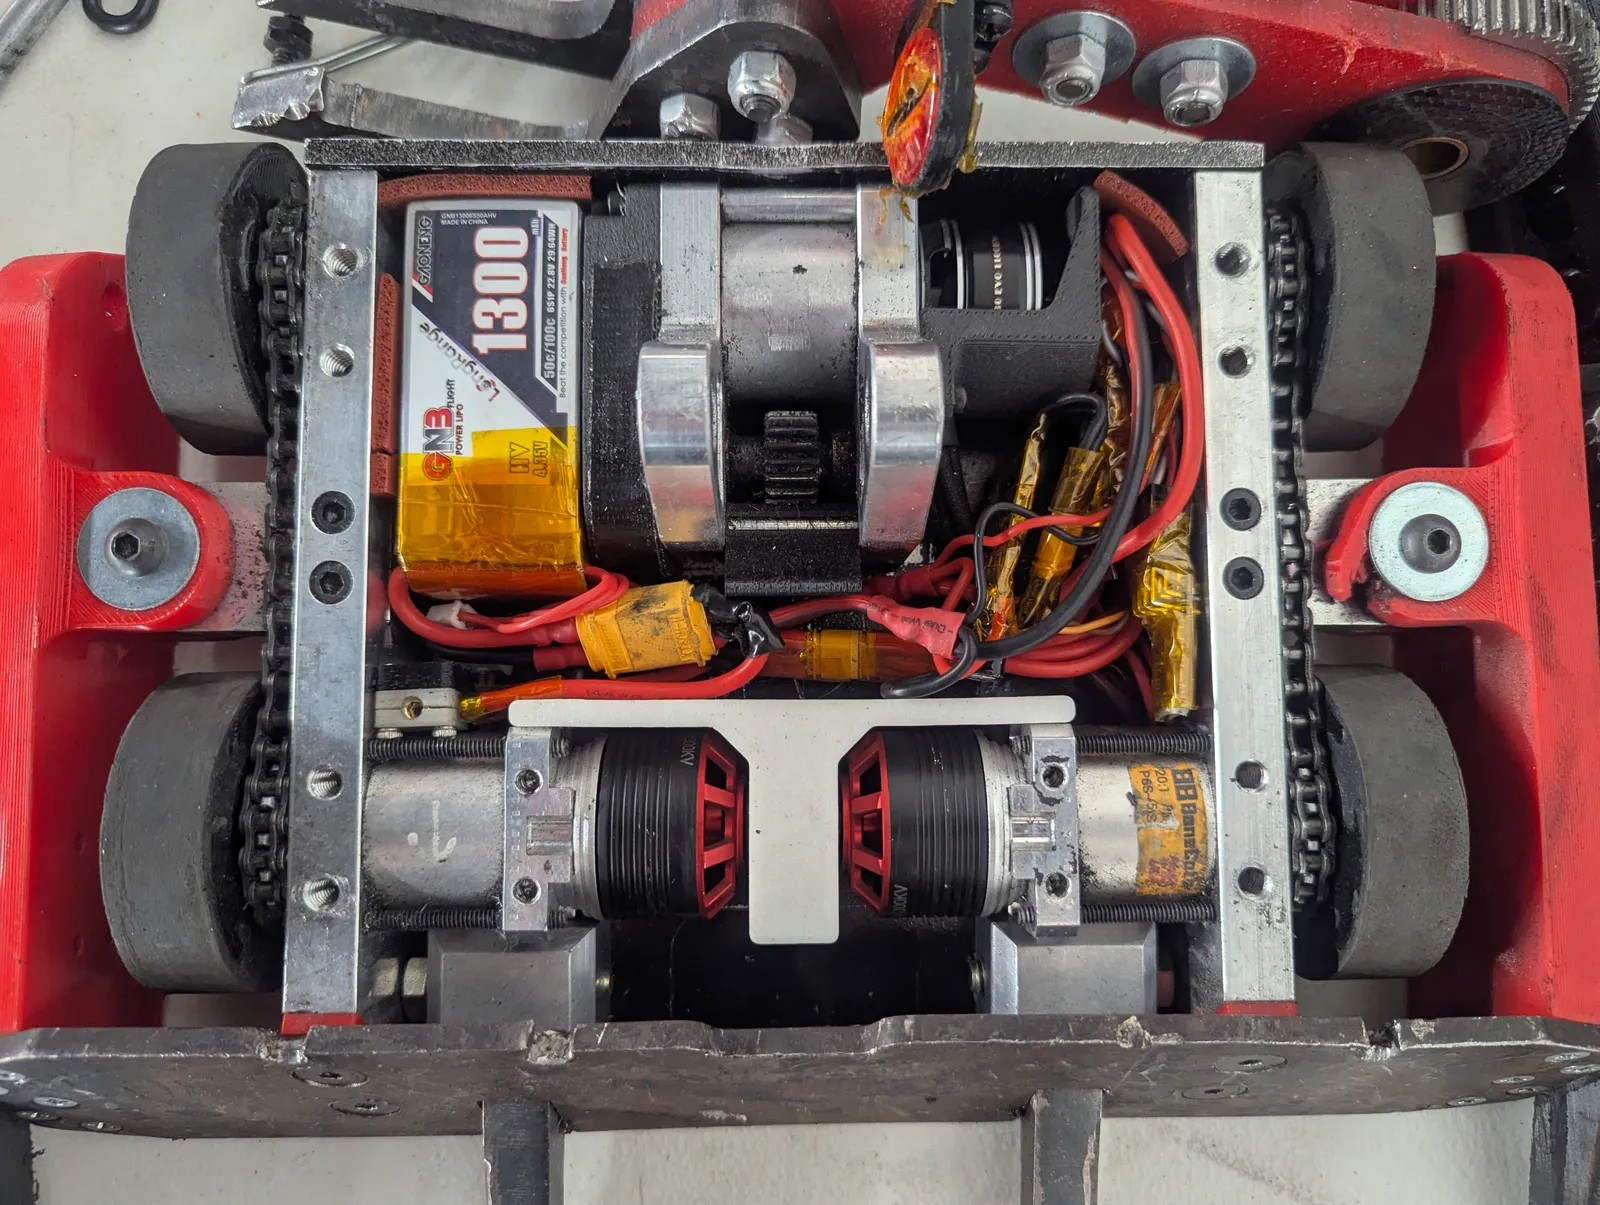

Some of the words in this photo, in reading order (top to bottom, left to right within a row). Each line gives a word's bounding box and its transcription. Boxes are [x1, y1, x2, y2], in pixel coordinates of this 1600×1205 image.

[547, 223, 557, 262] 29.64WH
[472, 226, 529, 356] 1300
[531, 219, 540, 237] mAh
[546, 264, 556, 289] 22.8V
[546, 292, 556, 313] 6S1P
[559, 287, 567, 305] with
[559, 306, 568, 360] competition
[559, 361, 567, 376] the
[559, 377, 567, 399] Beat
[456, 403, 464, 423] LIPO
[455, 425, 464, 456] POWER
[923, 619, 947, 634] Dual
[1155, 768, 1169, 793] 20:1
